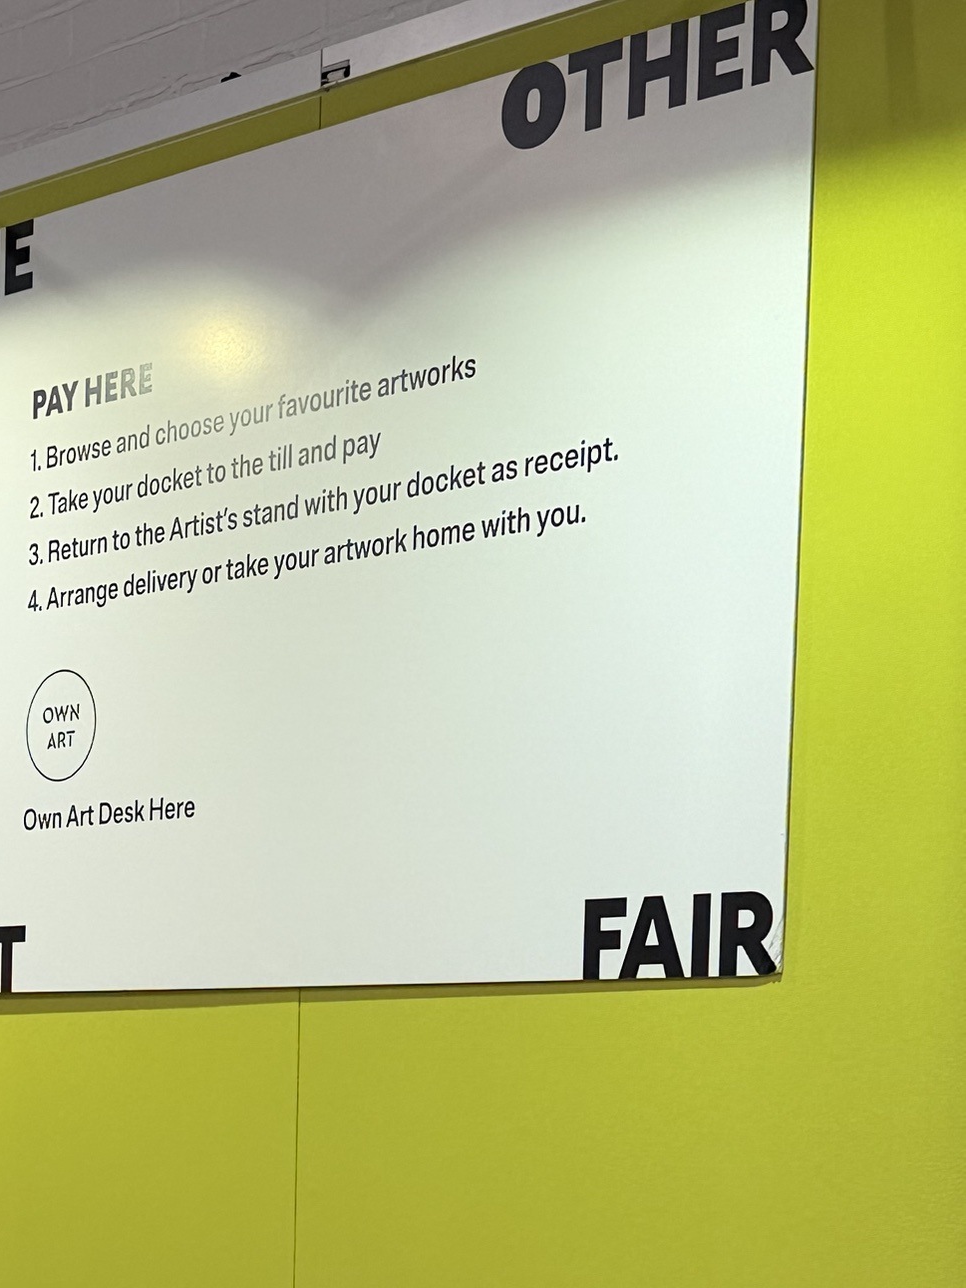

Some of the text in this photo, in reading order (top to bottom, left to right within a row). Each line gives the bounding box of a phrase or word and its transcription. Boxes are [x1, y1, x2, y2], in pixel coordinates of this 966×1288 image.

[501, 0, 815, 150] OTHER
[31, 355, 476, 472] 1. Browse and choose your favourite artworks
[33, 363, 152, 420] PAY HERE
[29, 543, 43, 565] 3.
[48, 536, 107, 563] Return
[112, 530, 130, 551] to
[135, 523, 165, 546] the
[243, 494, 299, 527] stand
[305, 486, 347, 516] with
[353, 481, 401, 515] your
[407, 462, 486, 498] docket
[492, 460, 517, 482] as
[525, 438, 618, 477] receipt.
[30, 432, 381, 519] 2. Take your docket to the till and pay
[28, 504, 586, 612] 4. Arrange delivery or take your artwork home with you.
[43, 703, 80, 724] OWN
[47, 730, 75, 749] ART
[24, 797, 195, 831] Own Art Desk Here
[582, 891, 778, 981] FAIR
